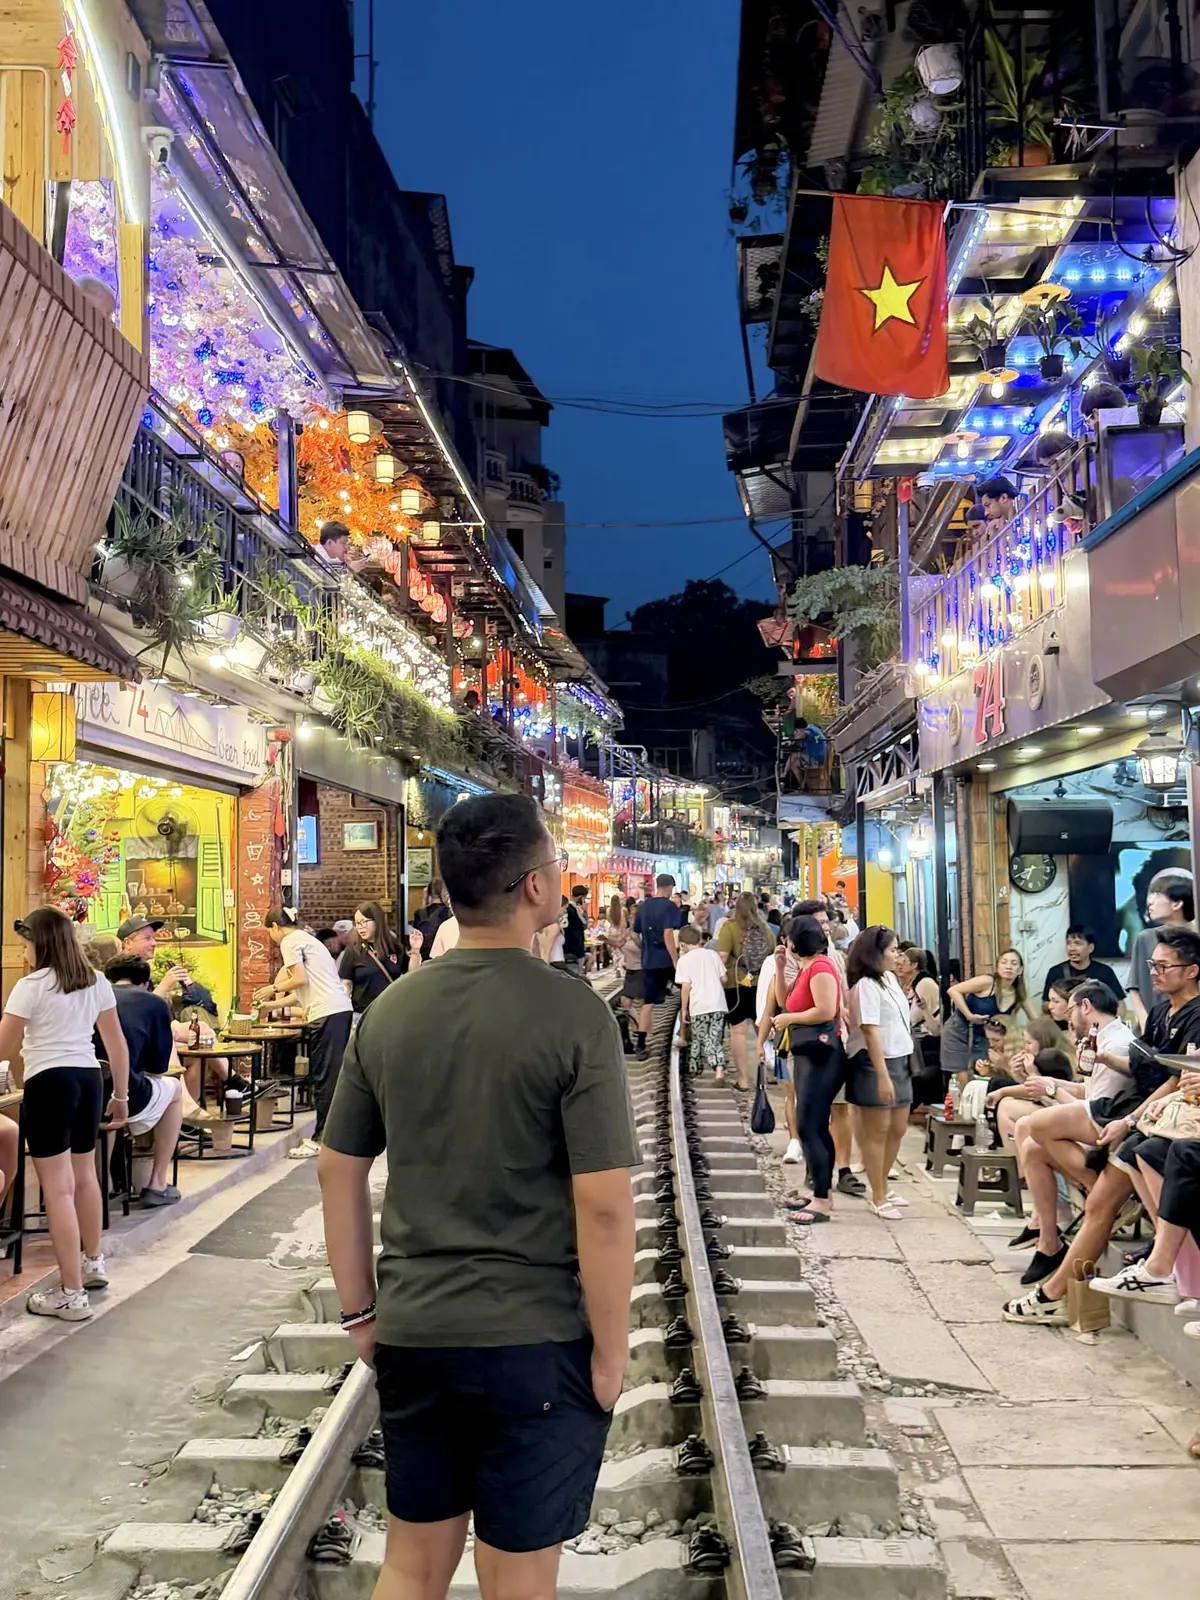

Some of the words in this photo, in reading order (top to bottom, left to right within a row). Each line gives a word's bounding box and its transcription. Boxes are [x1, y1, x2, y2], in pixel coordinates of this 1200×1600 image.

[127, 683, 149, 732] 74
[973, 657, 1005, 746] 74
[242, 740, 261, 770] food
